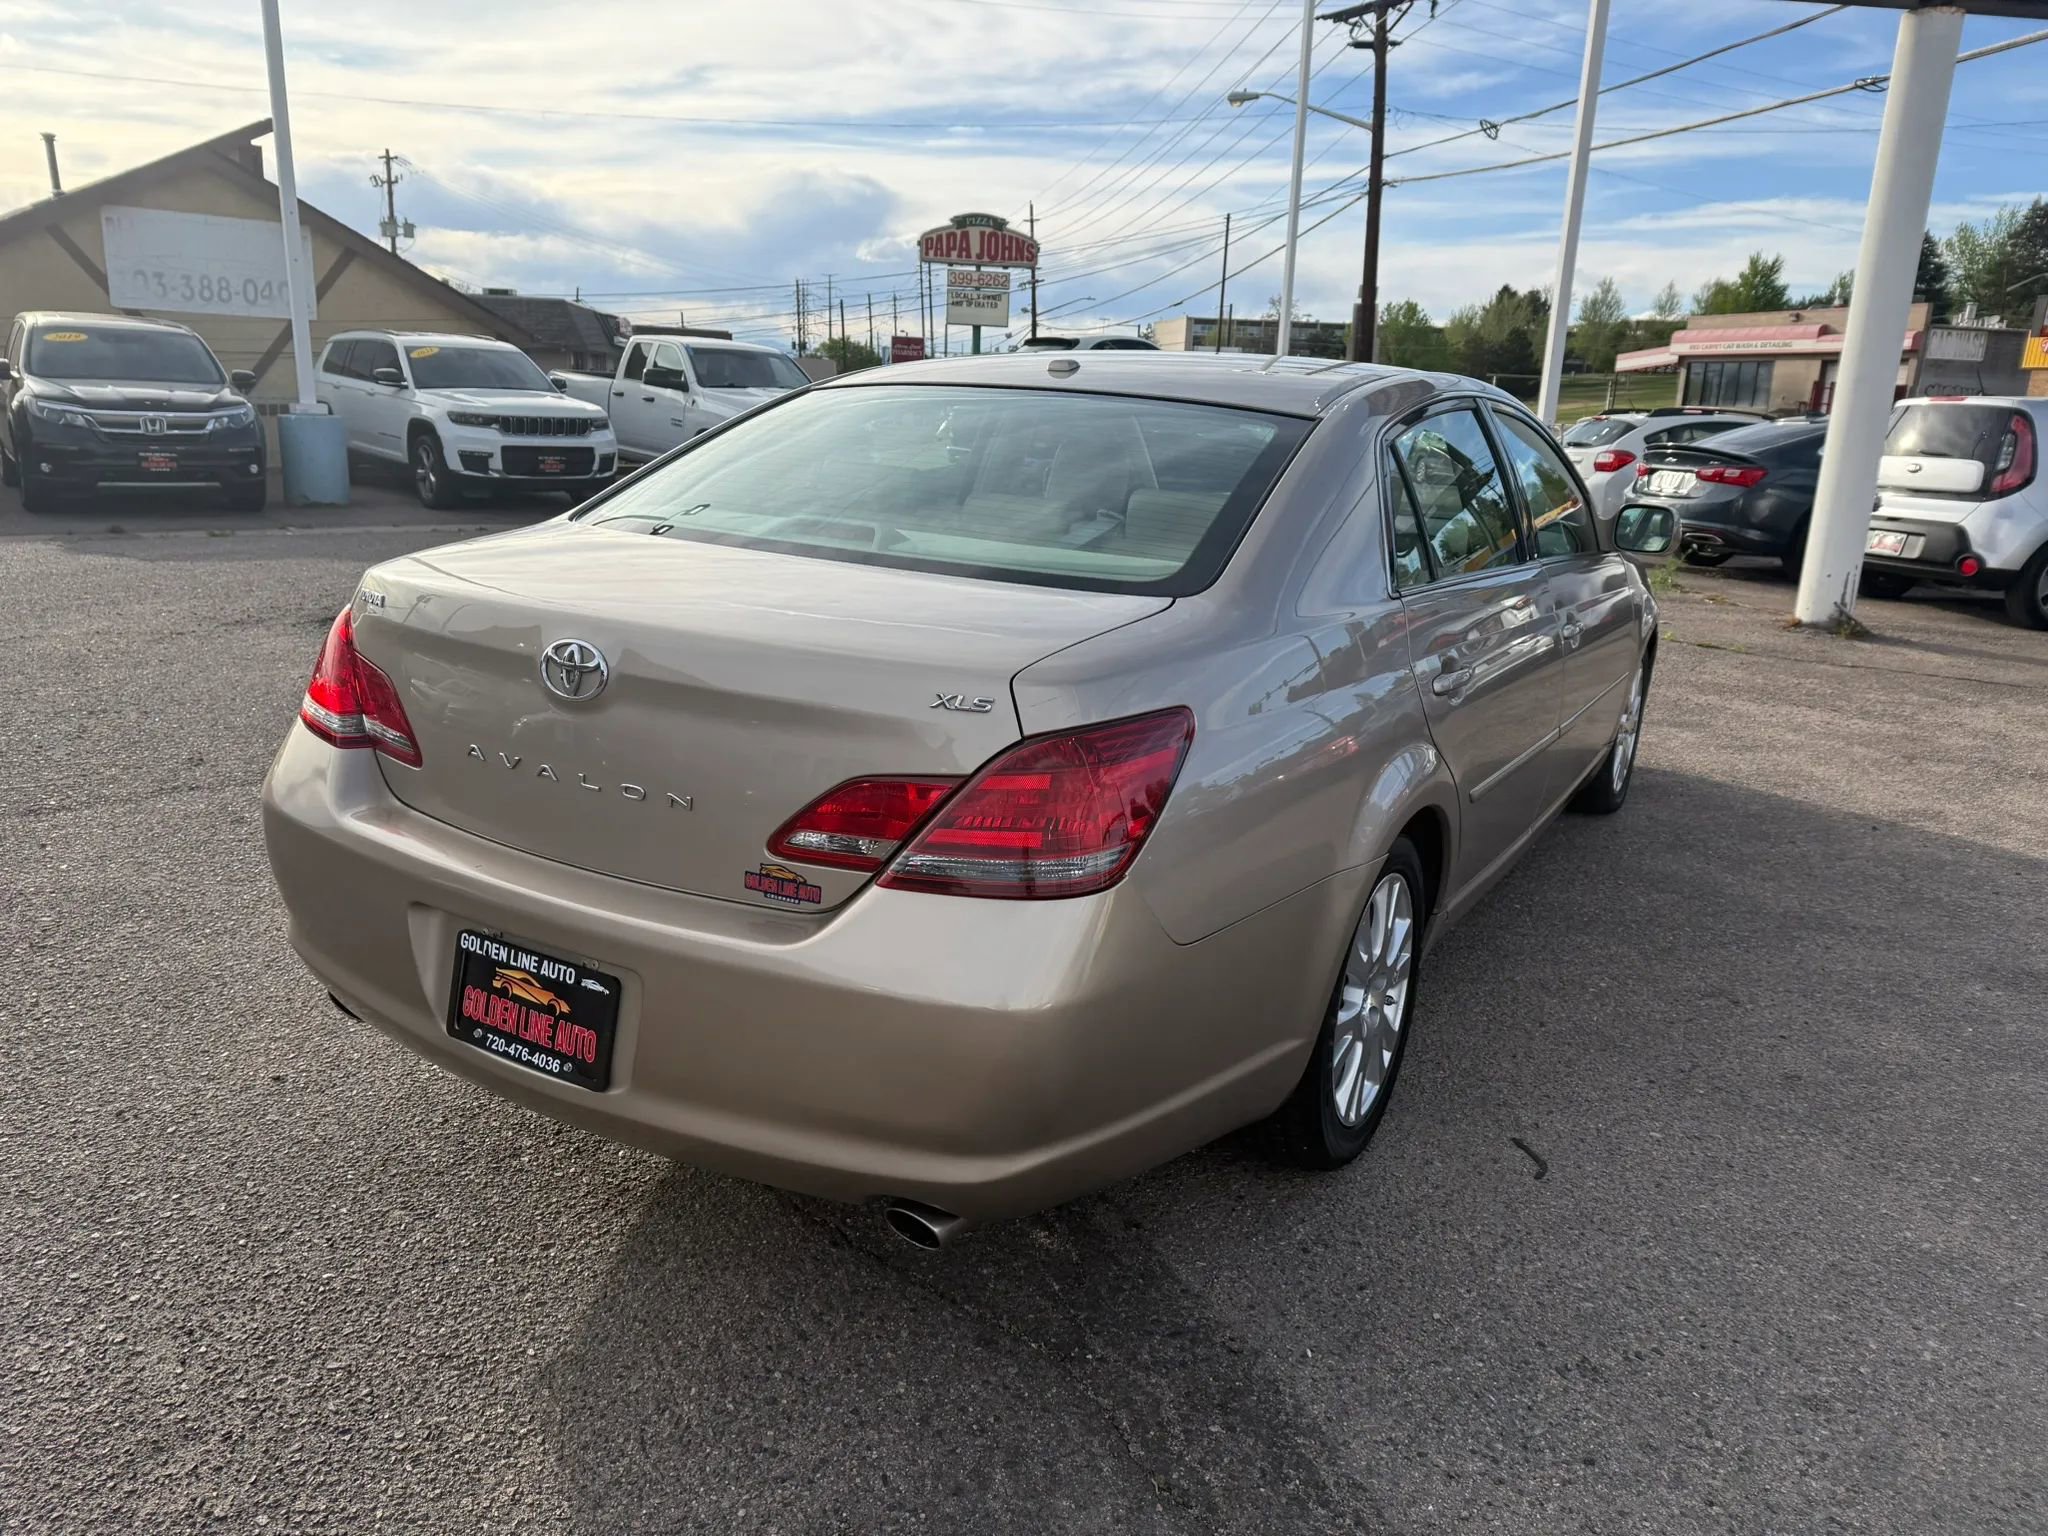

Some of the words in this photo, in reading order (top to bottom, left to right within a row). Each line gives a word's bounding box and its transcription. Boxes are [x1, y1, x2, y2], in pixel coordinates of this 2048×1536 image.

[966, 217, 993, 226] PIZZA
[924, 231, 972, 259] PAPA
[976, 231, 1035, 262] JOHNS
[950, 272, 1008, 287] 399-6262
[929, 693, 995, 714] XLS
[467, 743, 694, 812] AVALON
[460, 932, 508, 963] GOLDEN
[510, 949, 539, 973] LINE
[540, 960, 576, 984] AUTO
[462, 984, 519, 1035] GOLDEN
[519, 1006, 554, 1048] LINE
[555, 1020, 597, 1063] AUTO
[486, 1034, 561, 1073] 720-476-4036
